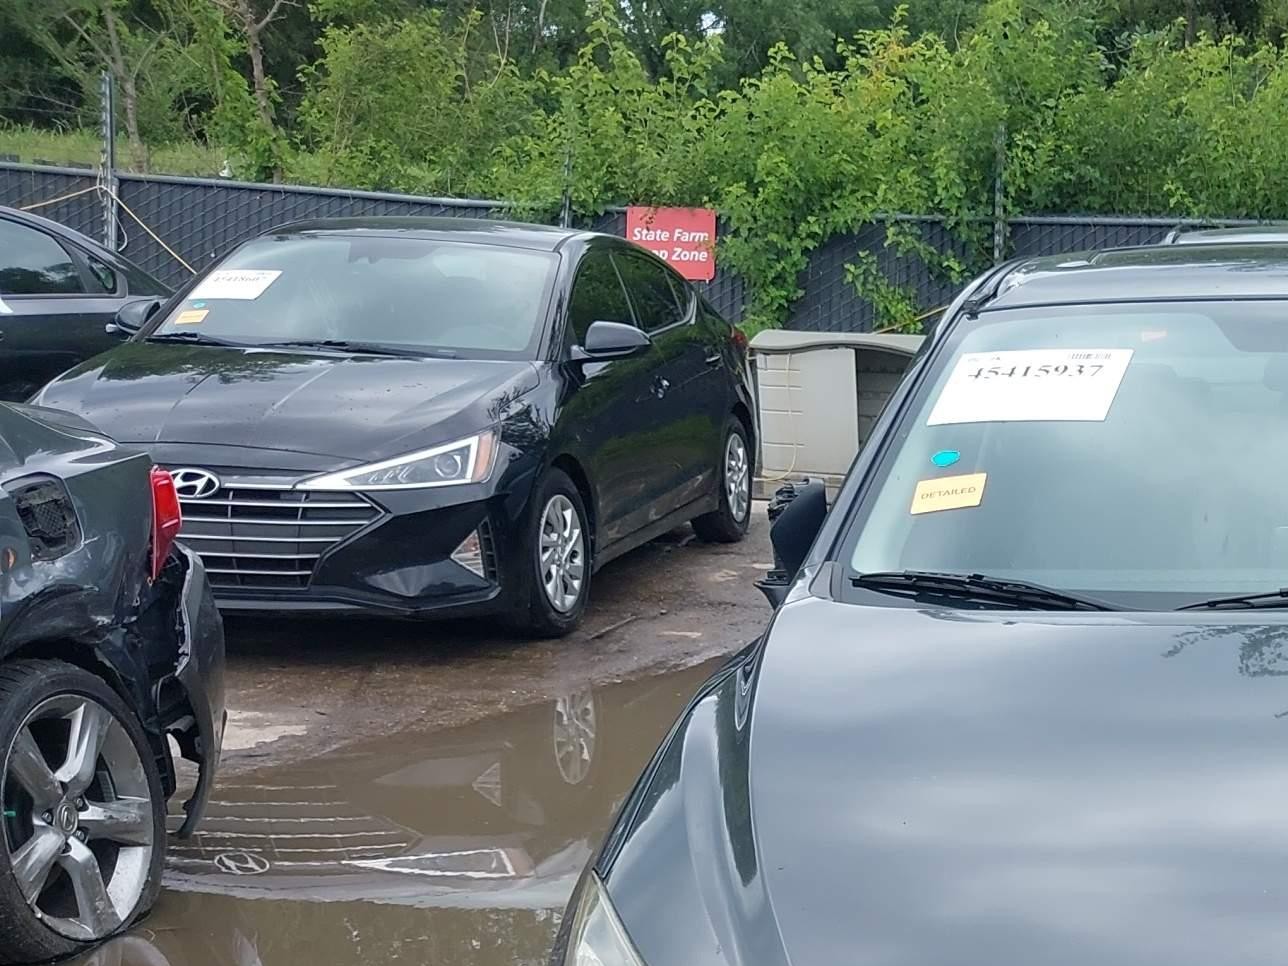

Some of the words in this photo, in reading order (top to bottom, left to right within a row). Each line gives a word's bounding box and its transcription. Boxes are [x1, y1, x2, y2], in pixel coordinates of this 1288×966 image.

[632, 227, 670, 242] State
[673, 228, 709, 242] Farm
[671, 247, 708, 262] Zone
[967, 364, 1105, 379] 45415937
[920, 486, 976, 500] DETAILED
